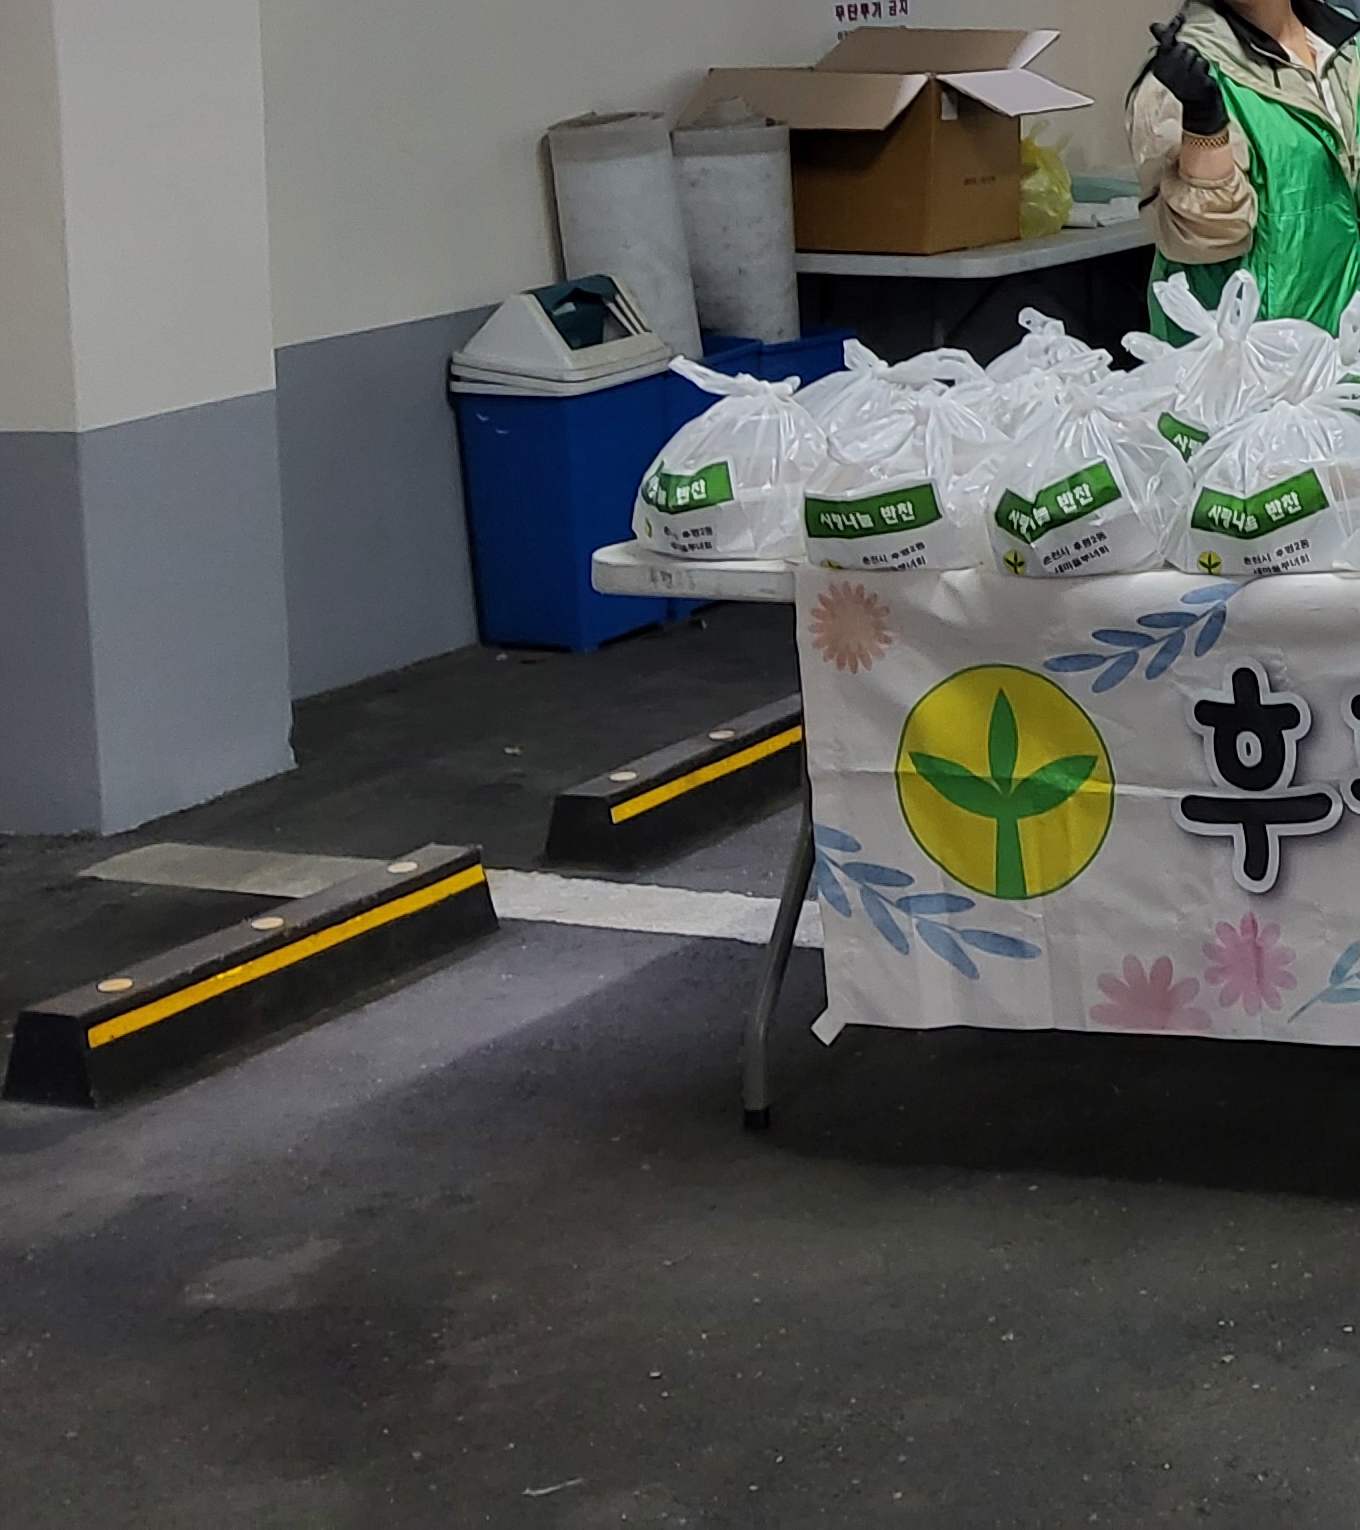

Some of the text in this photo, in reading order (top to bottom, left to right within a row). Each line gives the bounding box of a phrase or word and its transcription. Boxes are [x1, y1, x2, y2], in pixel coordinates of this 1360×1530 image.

[835, 1, 882, 22] 무단투기
[1056, 483, 1093, 515] 반찬
[880, 500, 916, 525] 반찬
[1208, 492, 1302, 533] 사랑나눔 반찬
[1074, 532, 1107, 551] 후평2동
[1275, 539, 1310, 557] 후평2동
